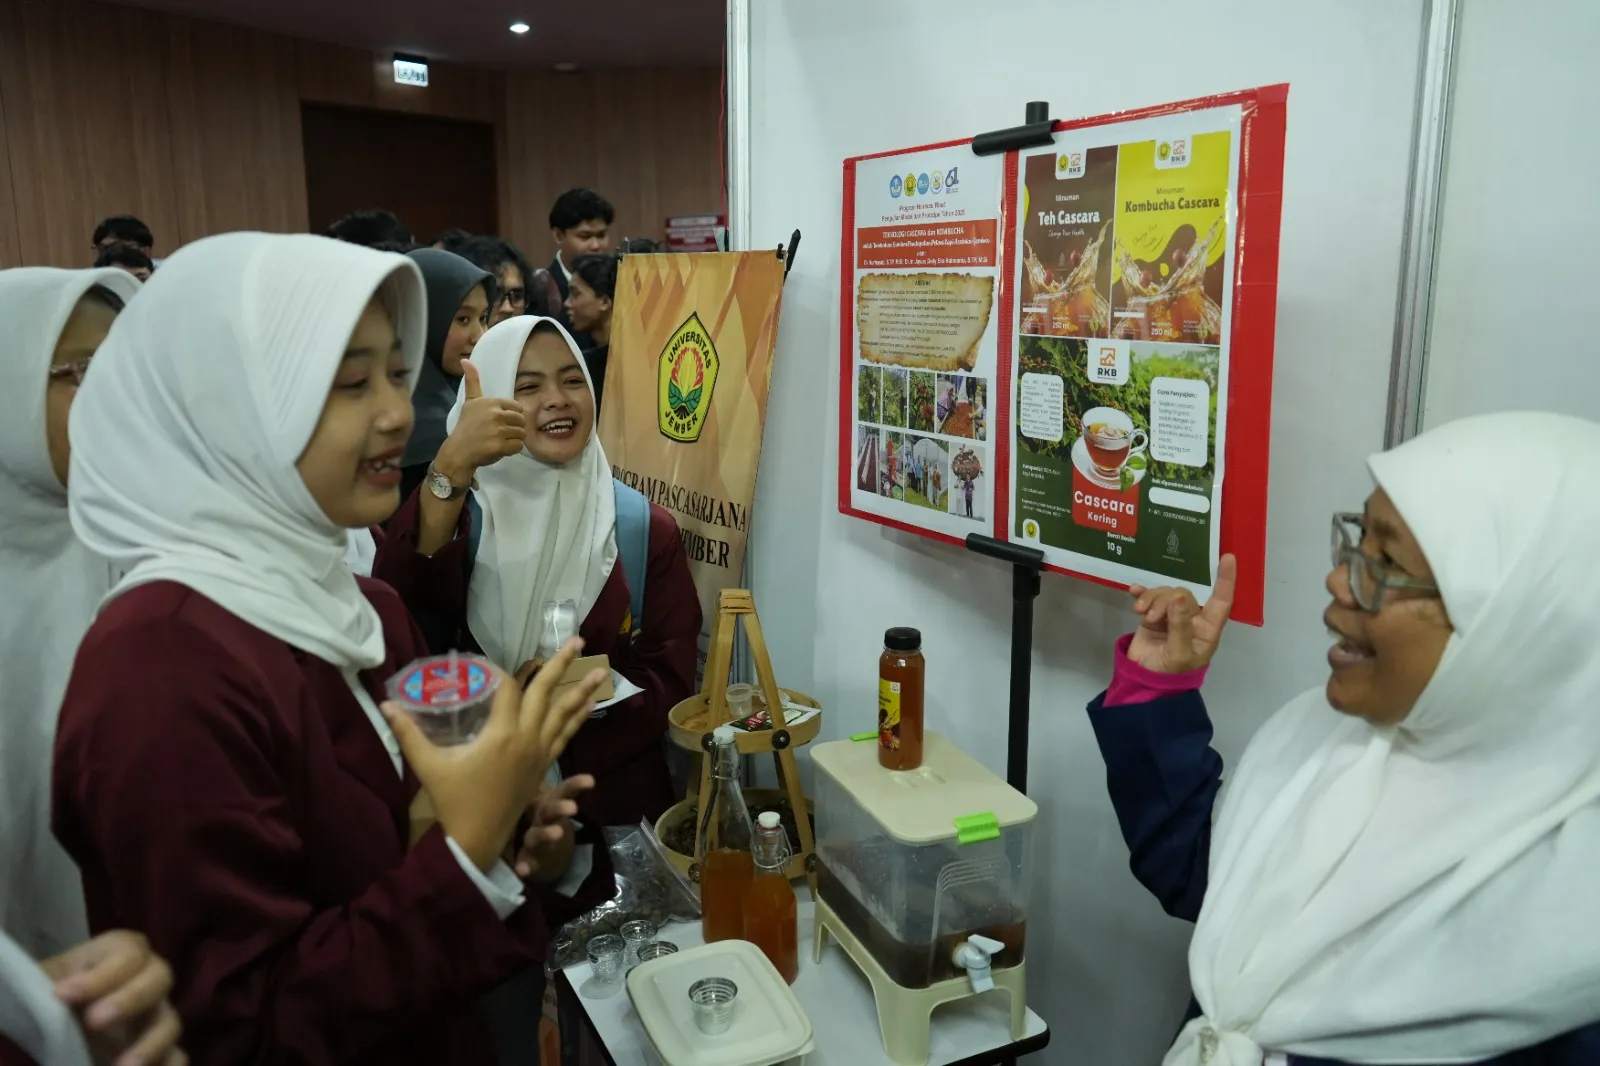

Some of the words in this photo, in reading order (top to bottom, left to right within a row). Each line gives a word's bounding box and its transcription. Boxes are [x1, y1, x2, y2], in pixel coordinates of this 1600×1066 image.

[1055, 194, 1080, 202] Minuman
[1156, 187, 1185, 195] Minuman
[1125, 198, 1175, 213] Kombucha
[1178, 197, 1220, 210] Cascara
[1037, 211, 1056, 226] Teh
[1057, 210, 1100, 225] Cascara
[667, 331, 712, 369] UNIVERSITAS
[1097, 367, 1117, 377] RKB
[665, 411, 699, 434] JEMBER
[657, 480, 747, 532] PASCASARJANA
[1074, 490, 1135, 516] Cascara
[1087, 511, 1117, 528] Kering
[1106, 541, 1116, 551] 10
[1116, 545, 1122, 555] g
